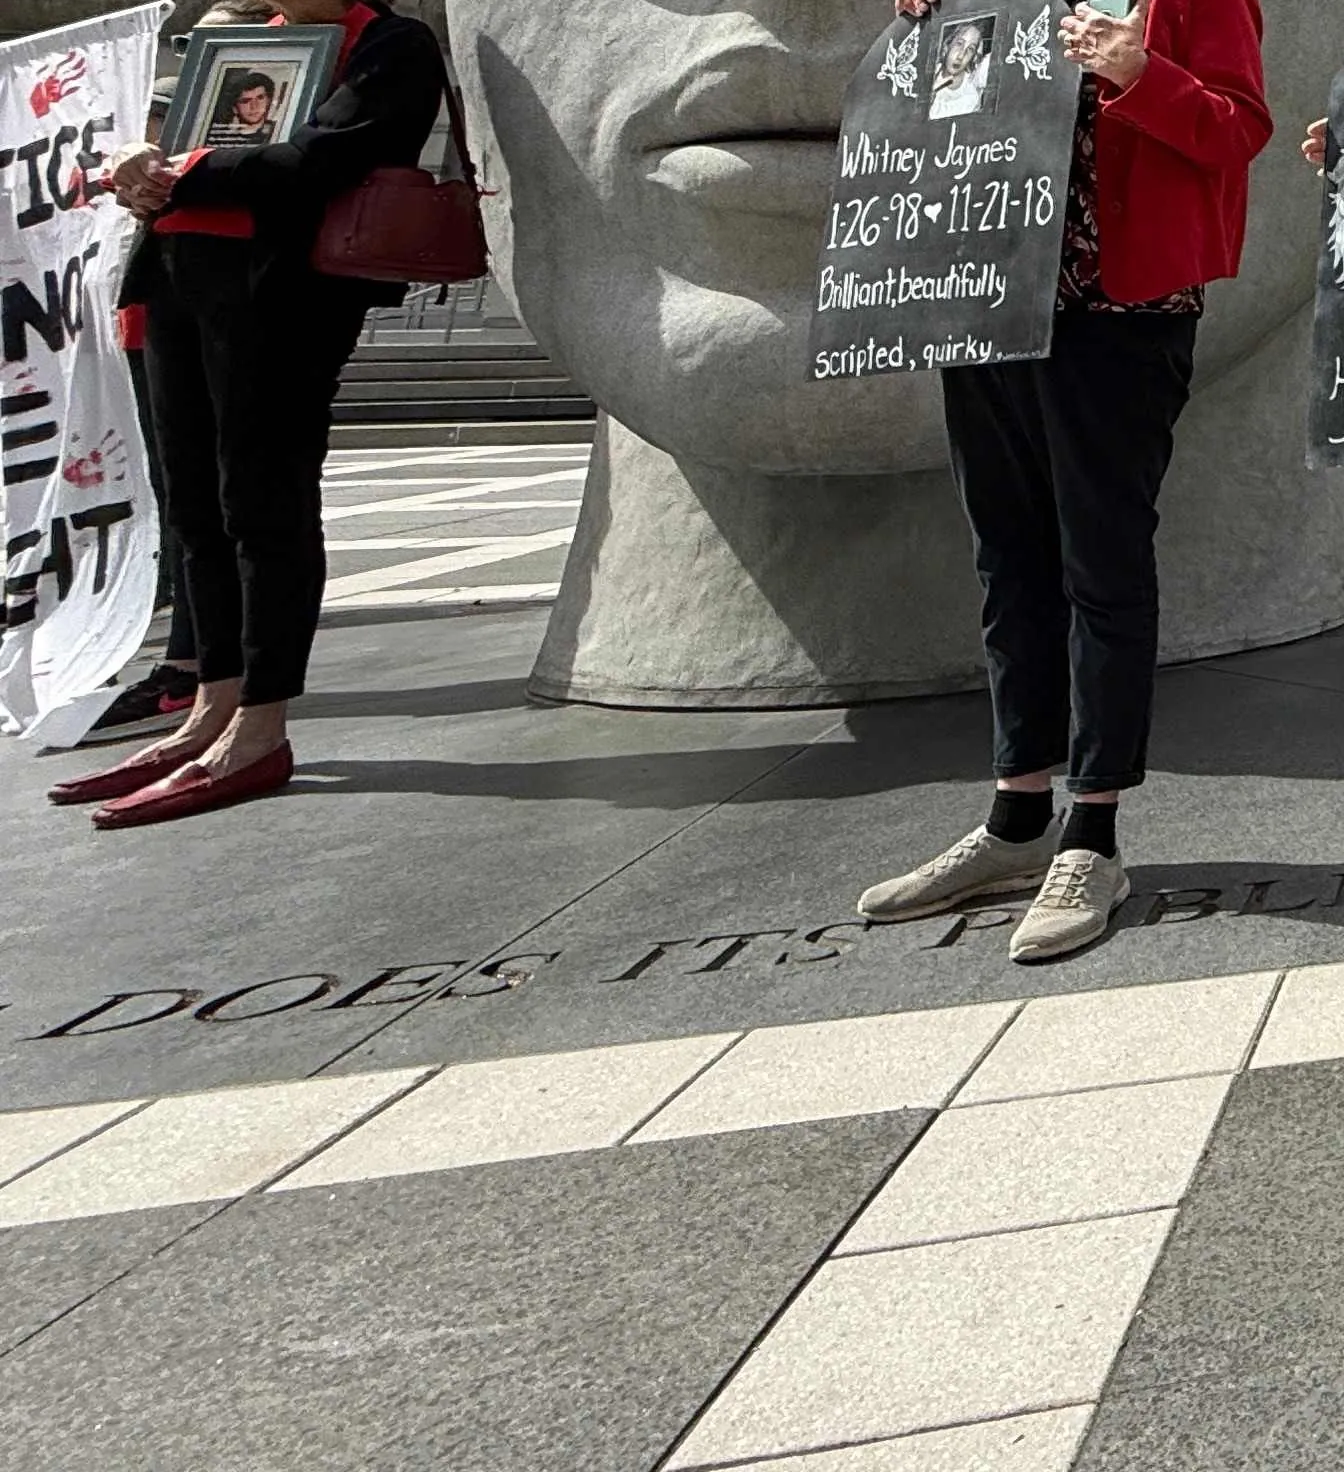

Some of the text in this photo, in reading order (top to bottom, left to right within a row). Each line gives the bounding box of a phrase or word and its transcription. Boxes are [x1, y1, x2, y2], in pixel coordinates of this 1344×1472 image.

[0, 112, 115, 229] ICE
[840, 122, 1018, 184] Whitney Jaynes
[827, 175, 1054, 250] 1-26-98 11-21-18
[814, 334, 993, 380] scripted, quirky
[18, 950, 561, 1041] DOES
[597, 919, 868, 984] ITS
